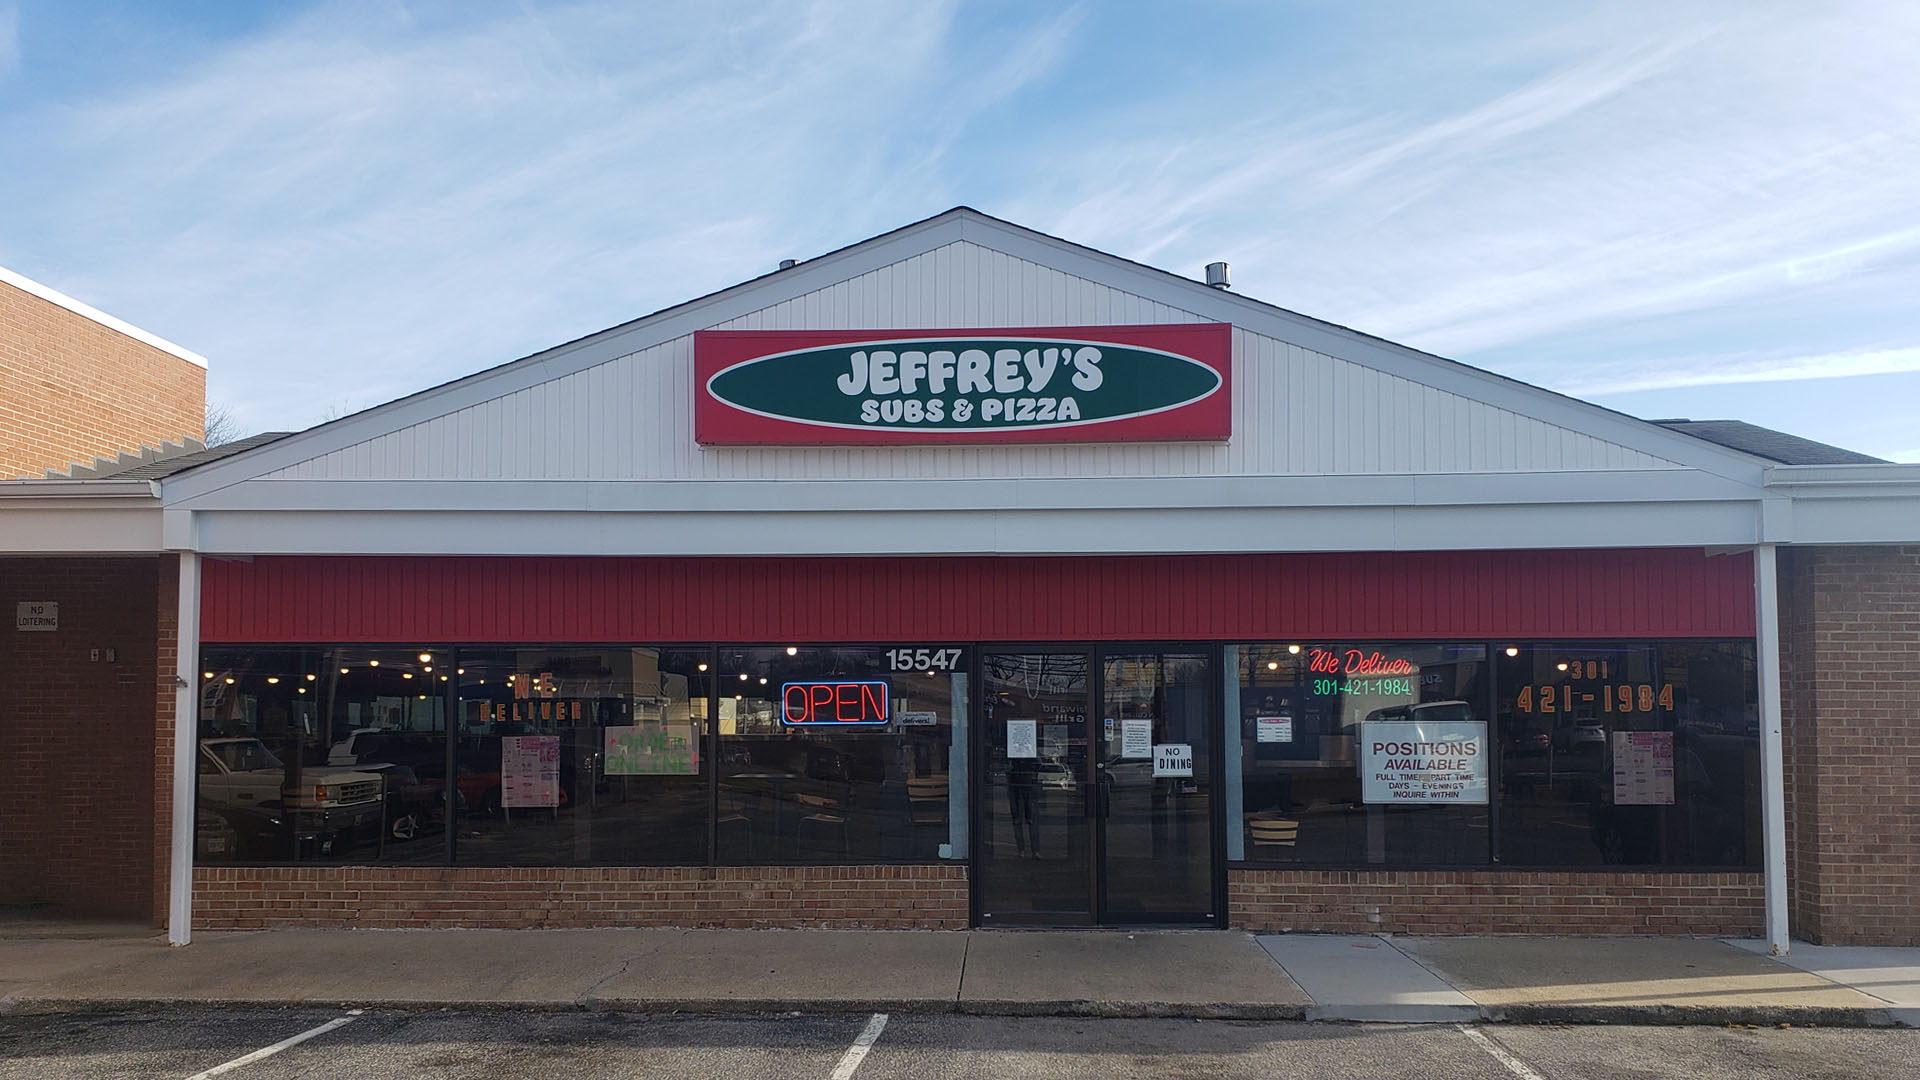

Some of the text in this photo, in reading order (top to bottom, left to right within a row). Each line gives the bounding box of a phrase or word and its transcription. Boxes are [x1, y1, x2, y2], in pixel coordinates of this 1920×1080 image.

[837, 347, 1103, 395] JEFFREY'S
[860, 397, 1081, 424] SUBS & PIZZA
[30, 606, 43, 615] NO
[18, 617, 56, 626] LOITERING
[886, 649, 962, 671] 15547
[1309, 649, 1413, 675] We Deliver
[1571, 661, 1608, 679] 301
[1313, 679, 1411, 696] 301-421-1984
[785, 684, 885, 722] OPEN
[1517, 684, 1673, 712] 421-1984
[480, 701, 581, 722] DELIVER
[1165, 747, 1180, 756] NO
[1373, 742, 1477, 756] POSITIONS
[1159, 758, 1192, 770] DINING
[1384, 759, 1467, 770] AVAILABLE
[1455, 773, 1474, 781] TIME
